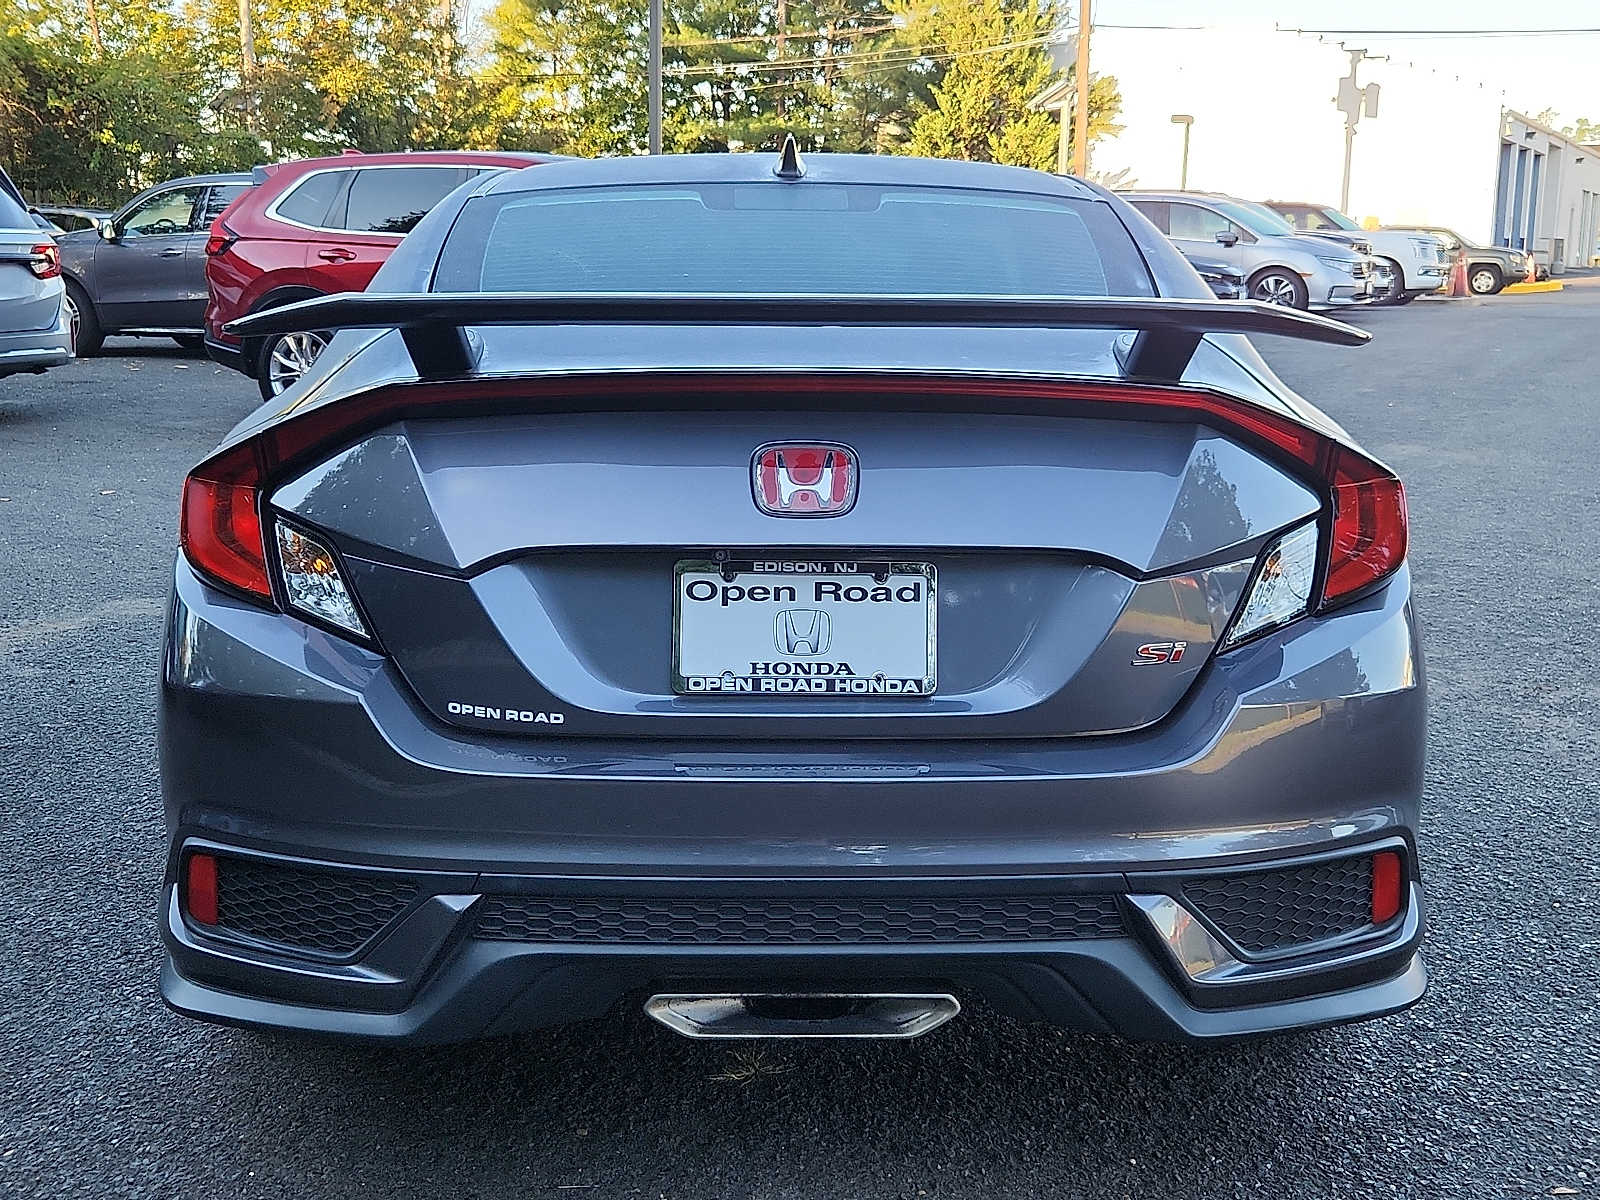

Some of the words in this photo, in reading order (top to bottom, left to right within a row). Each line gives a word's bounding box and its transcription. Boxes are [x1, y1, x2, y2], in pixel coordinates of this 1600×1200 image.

[753, 561, 827, 573] EDISON,
[833, 562, 858, 573] NJ
[685, 580, 797, 606] Open
[814, 581, 921, 603] Road
[1131, 641, 1187, 666] Si
[750, 662, 856, 676] HONDA
[688, 677, 753, 692] OPEN
[760, 678, 827, 692] ROAD
[835, 679, 920, 693] HONDA
[447, 702, 501, 719] OPEN
[505, 709, 564, 724] ROAD
